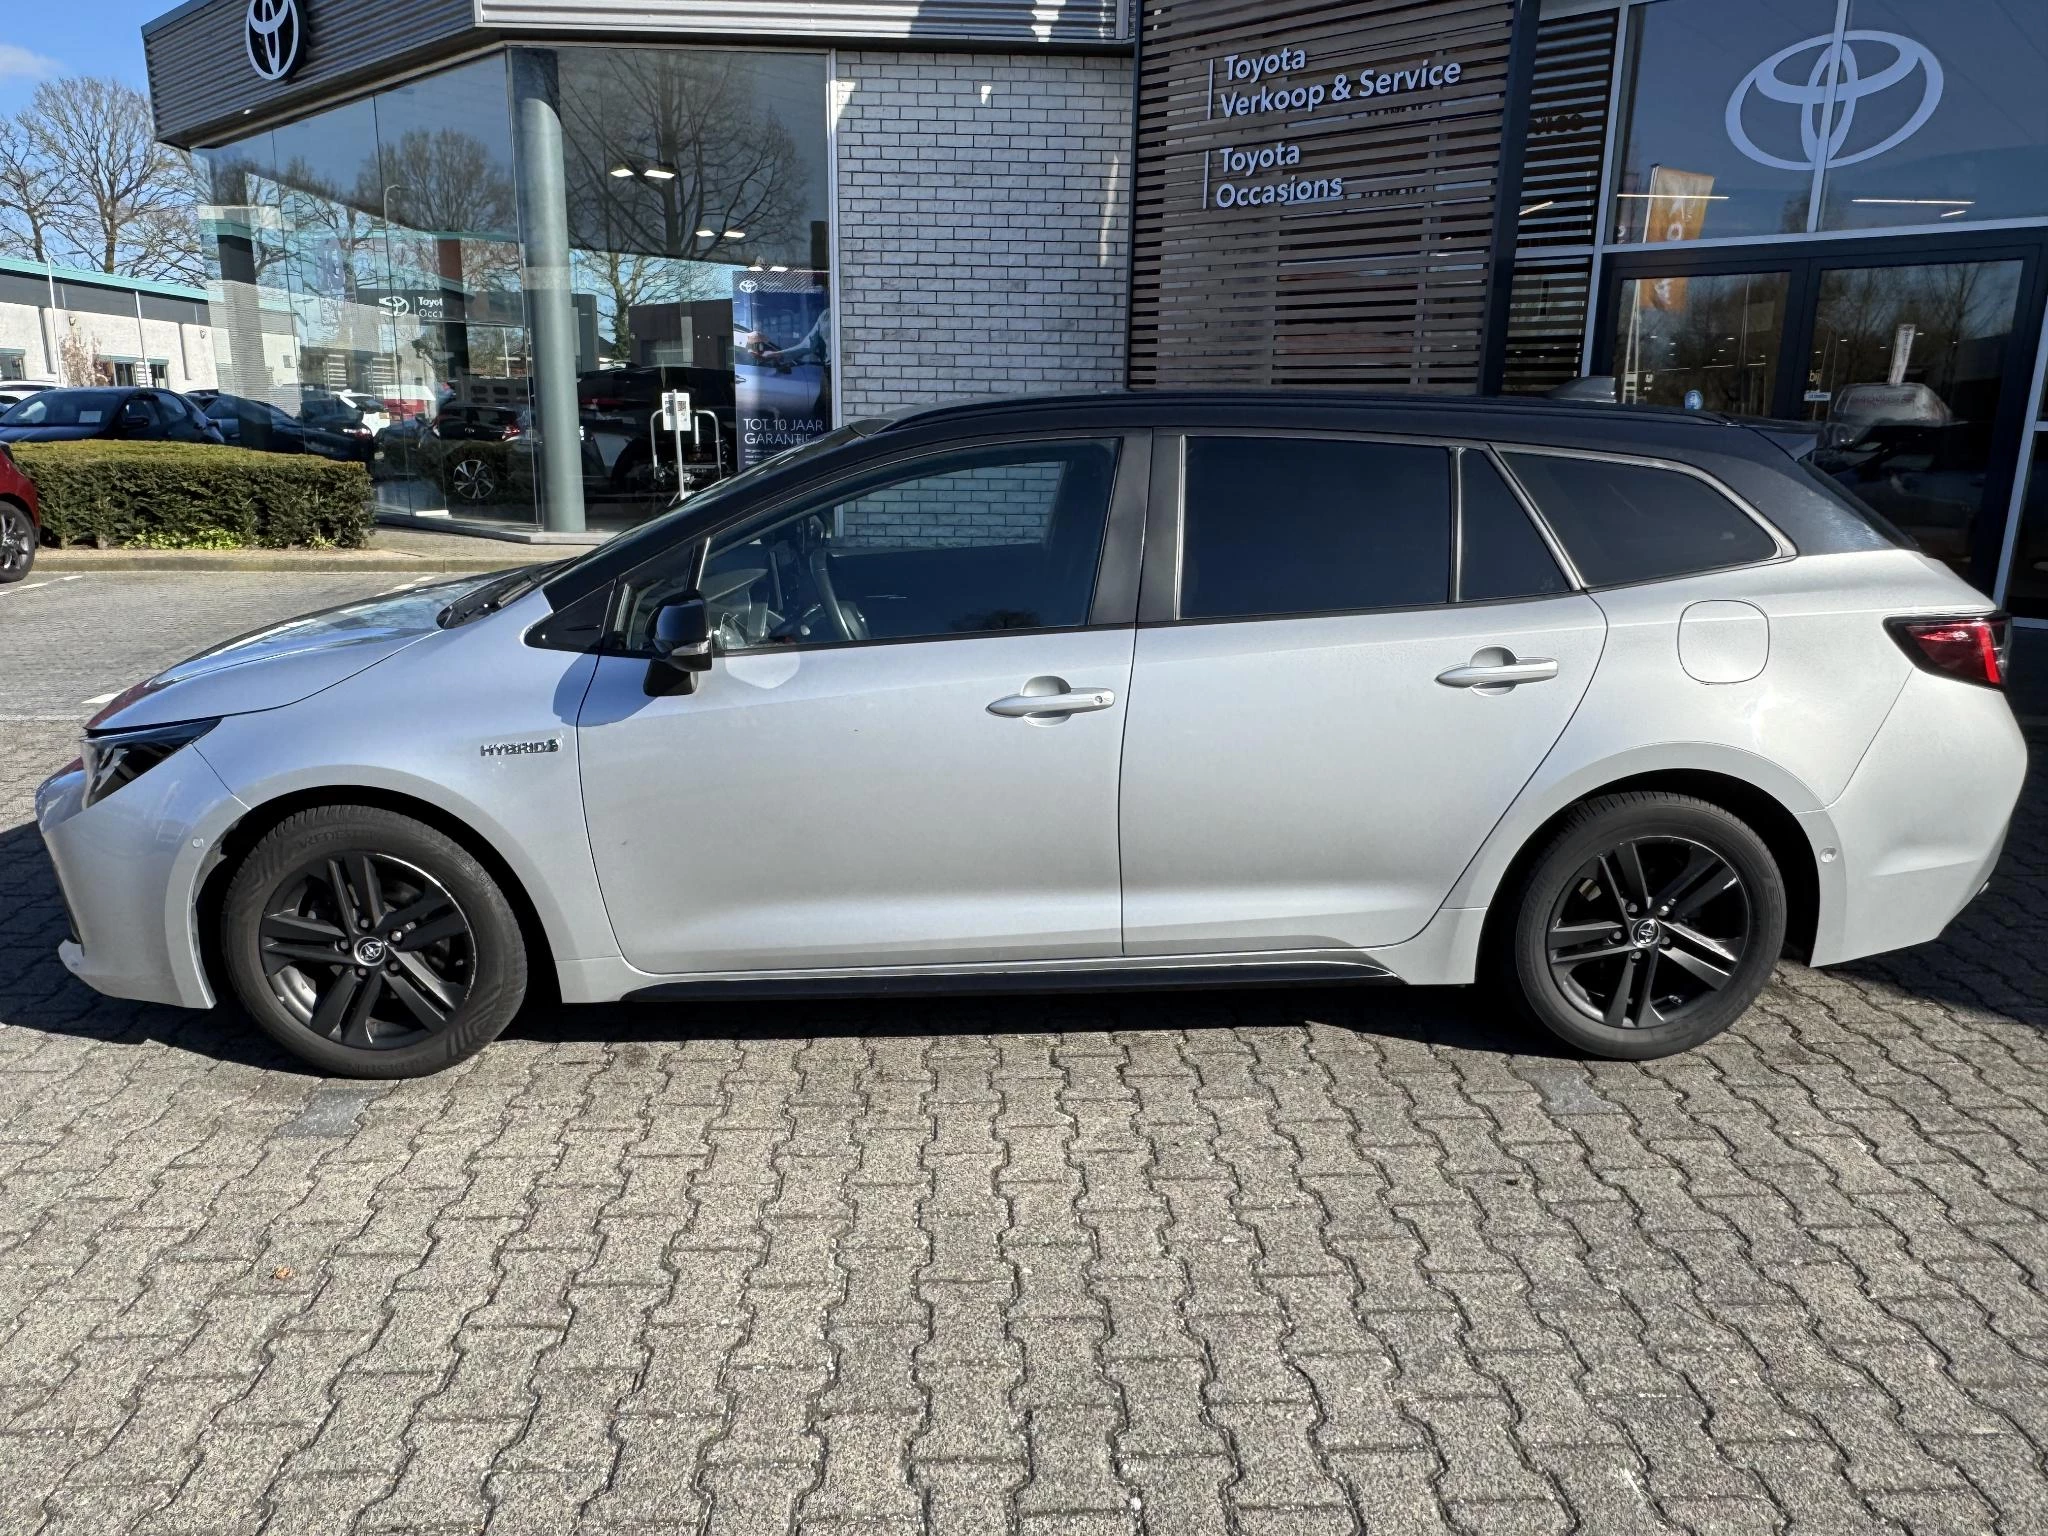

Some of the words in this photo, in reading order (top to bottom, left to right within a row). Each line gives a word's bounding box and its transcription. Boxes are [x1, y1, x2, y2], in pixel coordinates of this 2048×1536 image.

[1224, 47, 1306, 84] Toyota
[1221, 85, 1325, 119] Verkoop
[1331, 72, 1352, 101] &
[1359, 59, 1462, 98] Service
[1220, 142, 1300, 176] Toyota
[1216, 174, 1343, 209] Occasions
[743, 418, 769, 431] TOT
[773, 419, 787, 431] 10
[790, 419, 824, 432] JAAR
[480, 741, 545, 756] HYBRID
